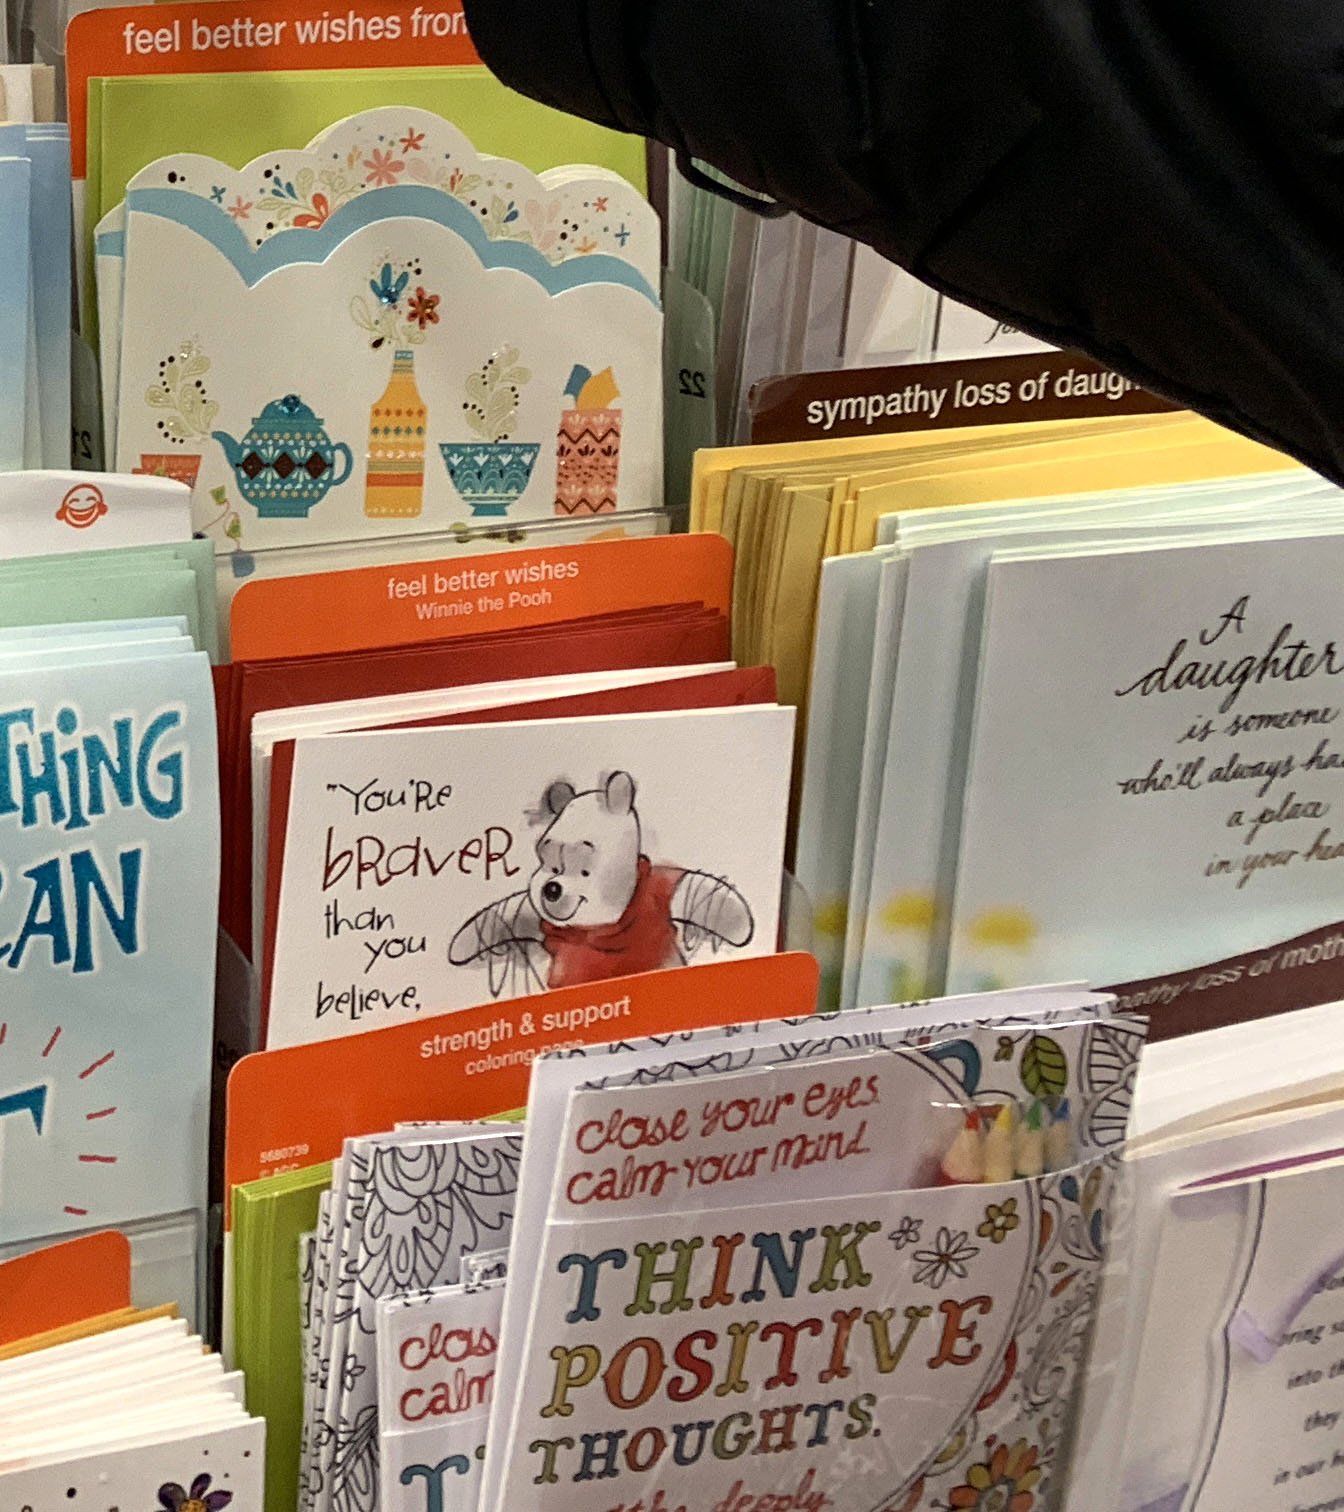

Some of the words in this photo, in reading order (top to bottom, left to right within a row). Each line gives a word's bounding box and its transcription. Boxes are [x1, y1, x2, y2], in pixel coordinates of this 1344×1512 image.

[123, 20, 179, 54] feel
[192, 14, 285, 48] better
[295, 11, 401, 44] wishes
[807, 384, 947, 430] sympathy
[954, 380, 1011, 408] loss
[1019, 371, 1050, 401] of
[388, 575, 426, 598] feel
[435, 570, 499, 593] better
[505, 560, 578, 584] wishes
[416, 599, 473, 621] Winnie
[478, 596, 504, 612] the
[509, 589, 551, 608] Pooh
[1200, 595, 1250, 645] A
[1115, 623, 1344, 714] daughter
[1177, 715, 1216, 743] is
[1224, 707, 1340, 736] someone
[325, 899, 394, 938] than
[364, 936, 426, 973] you
[420, 1020, 513, 1058] strength
[520, 1013, 535, 1035] &
[542, 996, 631, 1031] support
[558, 1221, 882, 1322] THINK
[540, 1293, 994, 1417] POSITIVE
[529, 1393, 882, 1482] THOUGHTS.
